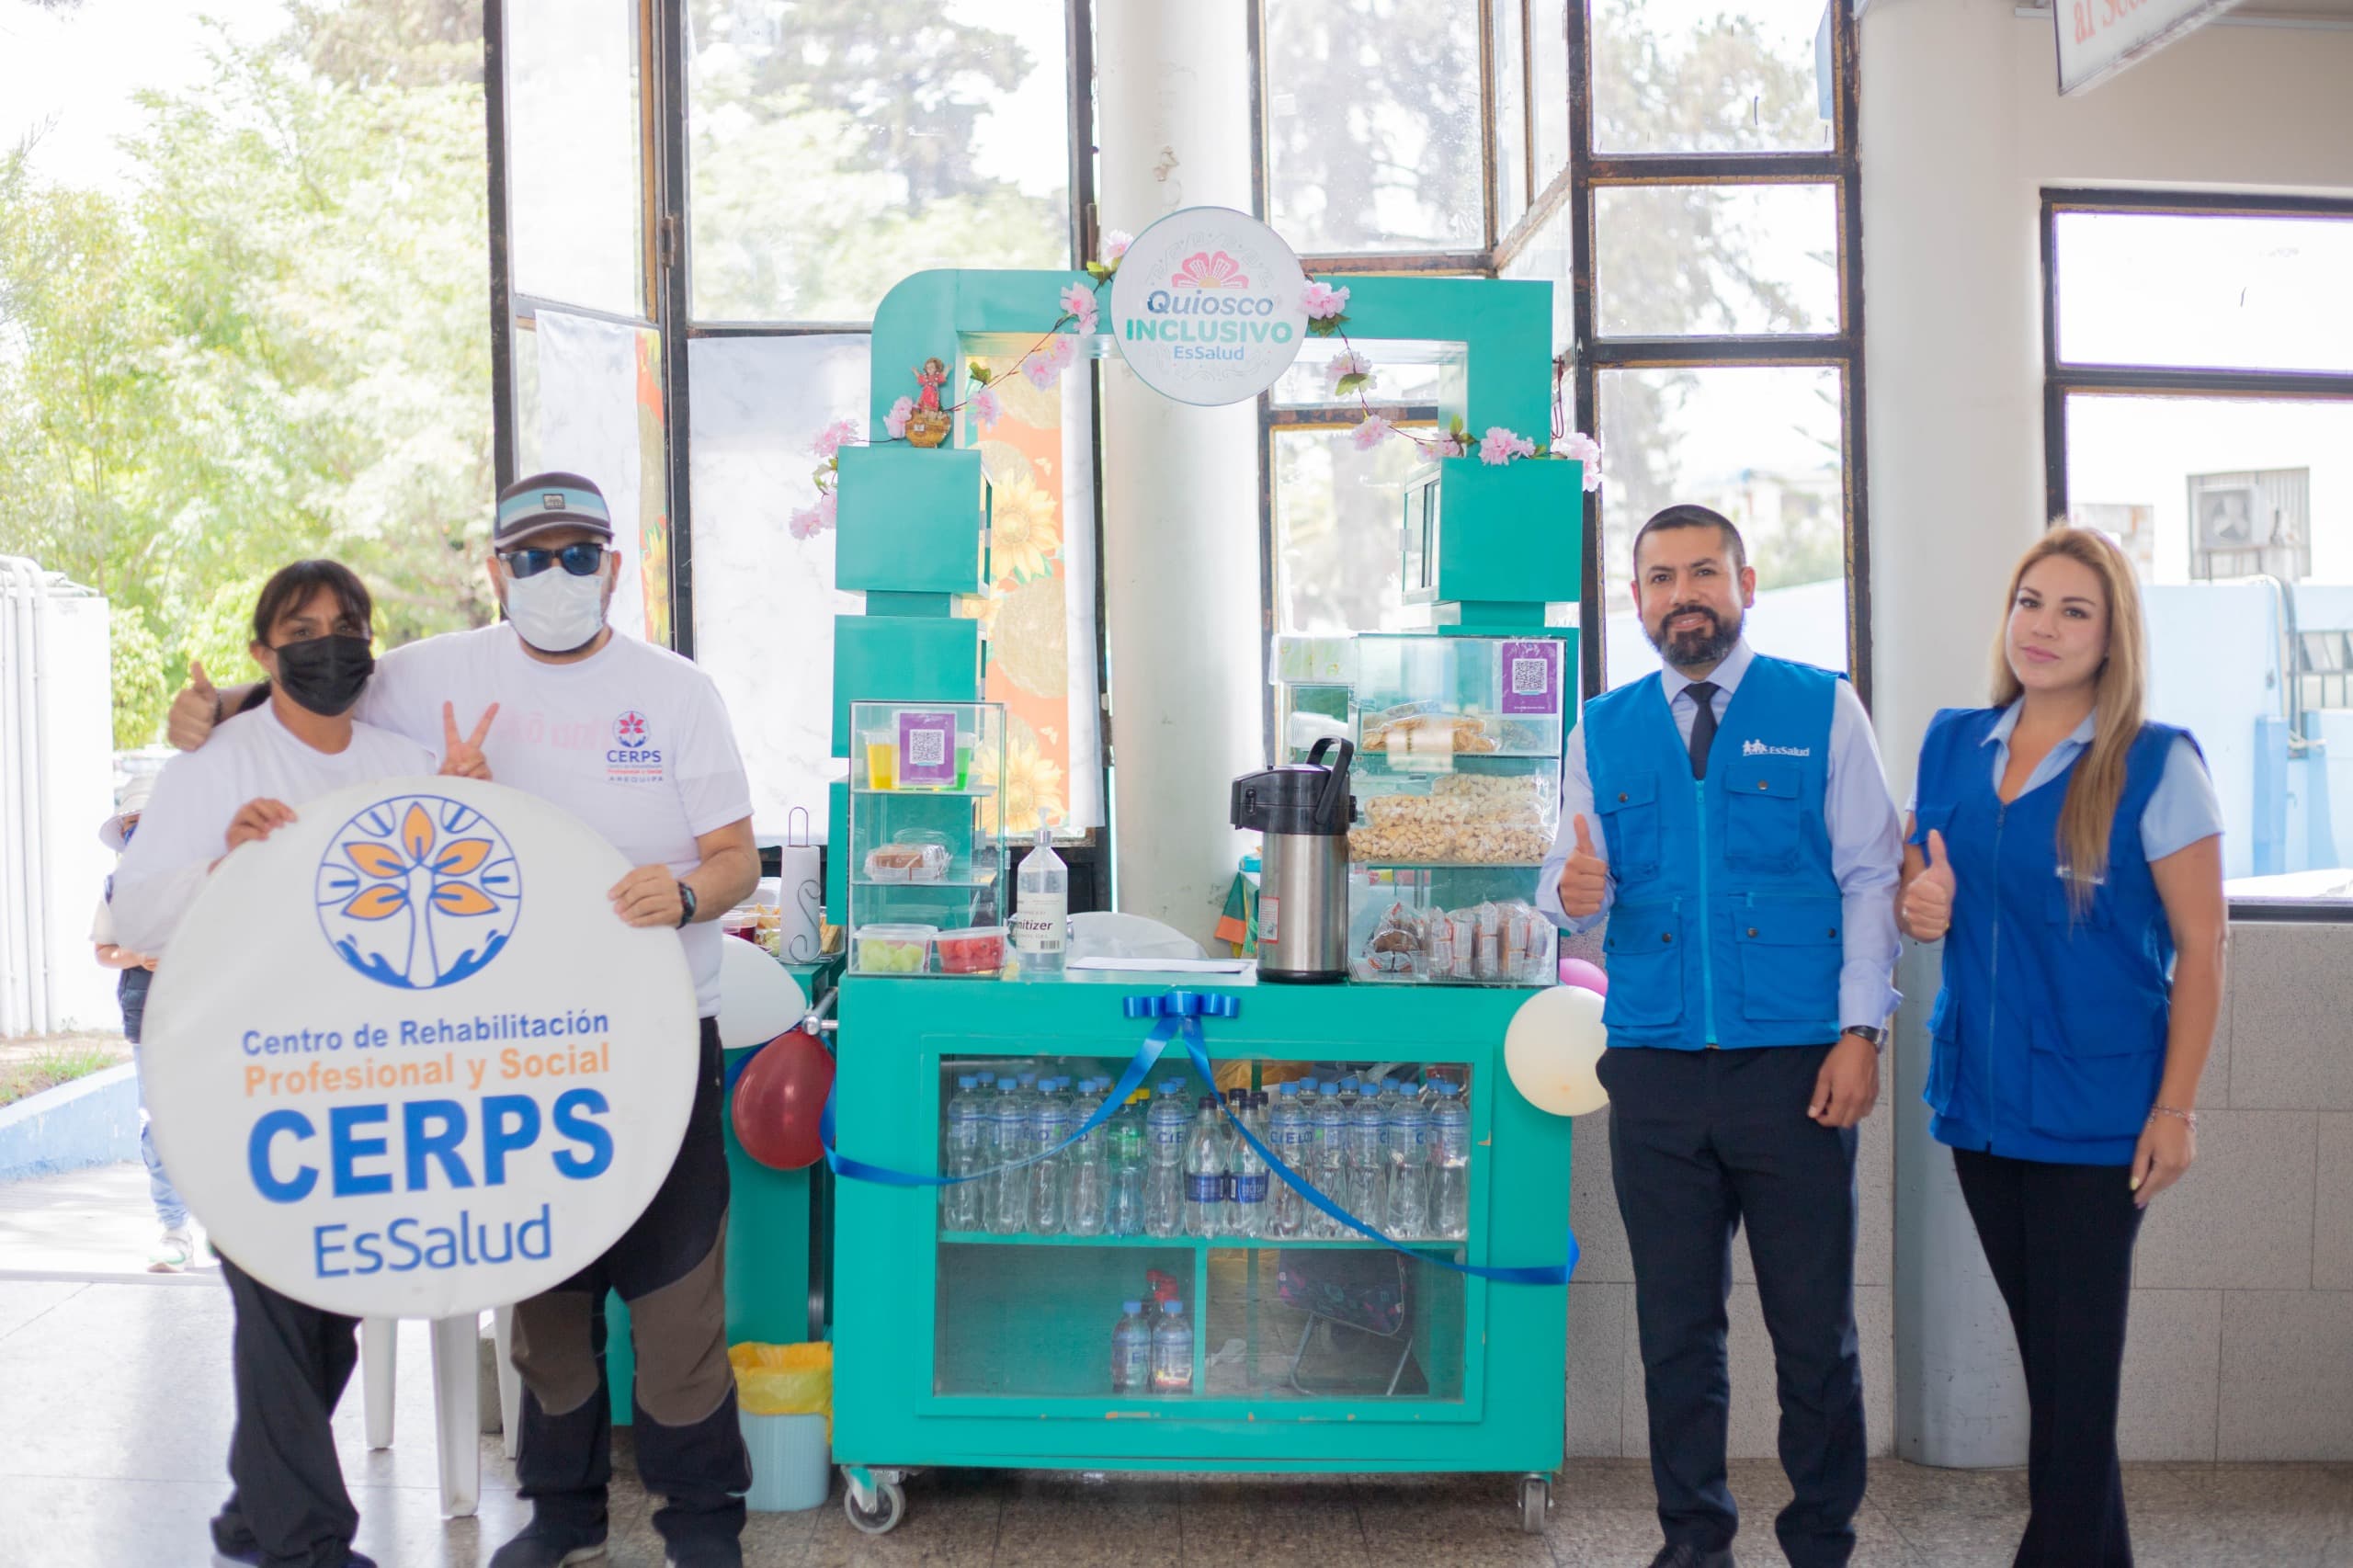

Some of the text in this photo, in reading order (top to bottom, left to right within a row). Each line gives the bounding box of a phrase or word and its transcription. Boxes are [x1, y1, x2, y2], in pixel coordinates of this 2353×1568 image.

[1147, 290, 1274, 317] Quiosco
[1126, 319, 1293, 344] INCLUSIVO
[1174, 346, 1245, 360] EsSalud
[607, 750, 662, 763] CERPS
[1769, 745, 1810, 756] EsSalud
[242, 1009, 609, 1056] Centro de Rehabilitación
[244, 1042, 610, 1096] Profesional y Social
[246, 1087, 615, 1204] CERPS
[313, 1203, 551, 1279] EsSalud
